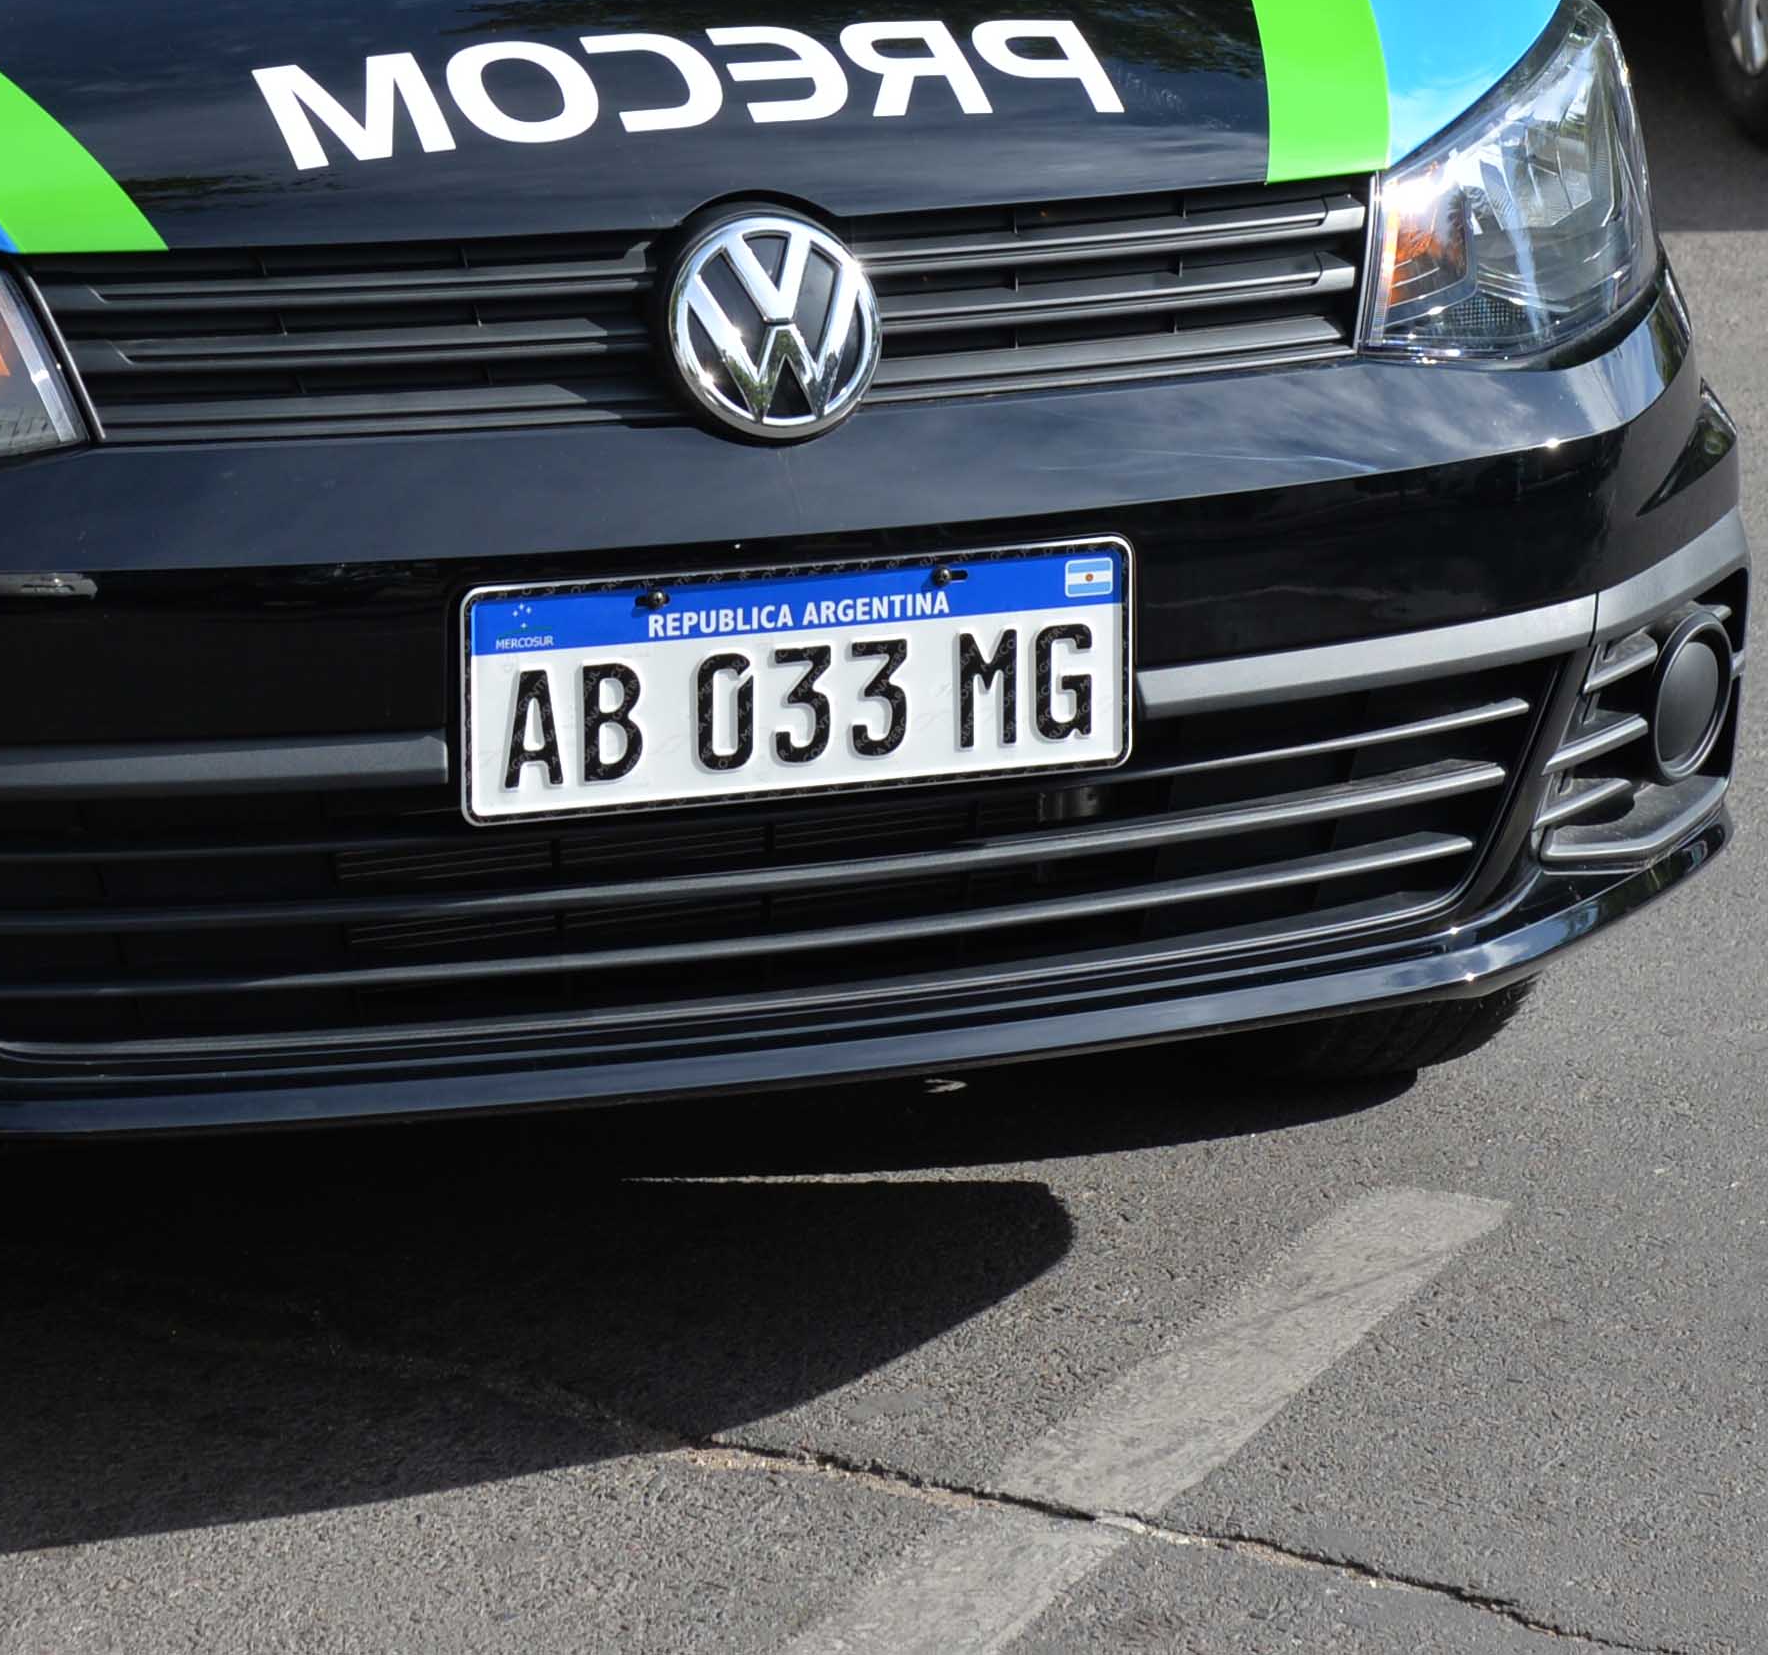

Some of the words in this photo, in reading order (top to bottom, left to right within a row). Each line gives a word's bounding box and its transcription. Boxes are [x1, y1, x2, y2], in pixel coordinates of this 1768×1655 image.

[648, 603, 793, 638] REPUBLICA
[802, 591, 951, 626] ARGENTINA
[495, 634, 555, 650] MERCOSUR
[504, 662, 643, 790] AB
[697, 638, 909, 772] 033
[958, 623, 1094, 749] MG
